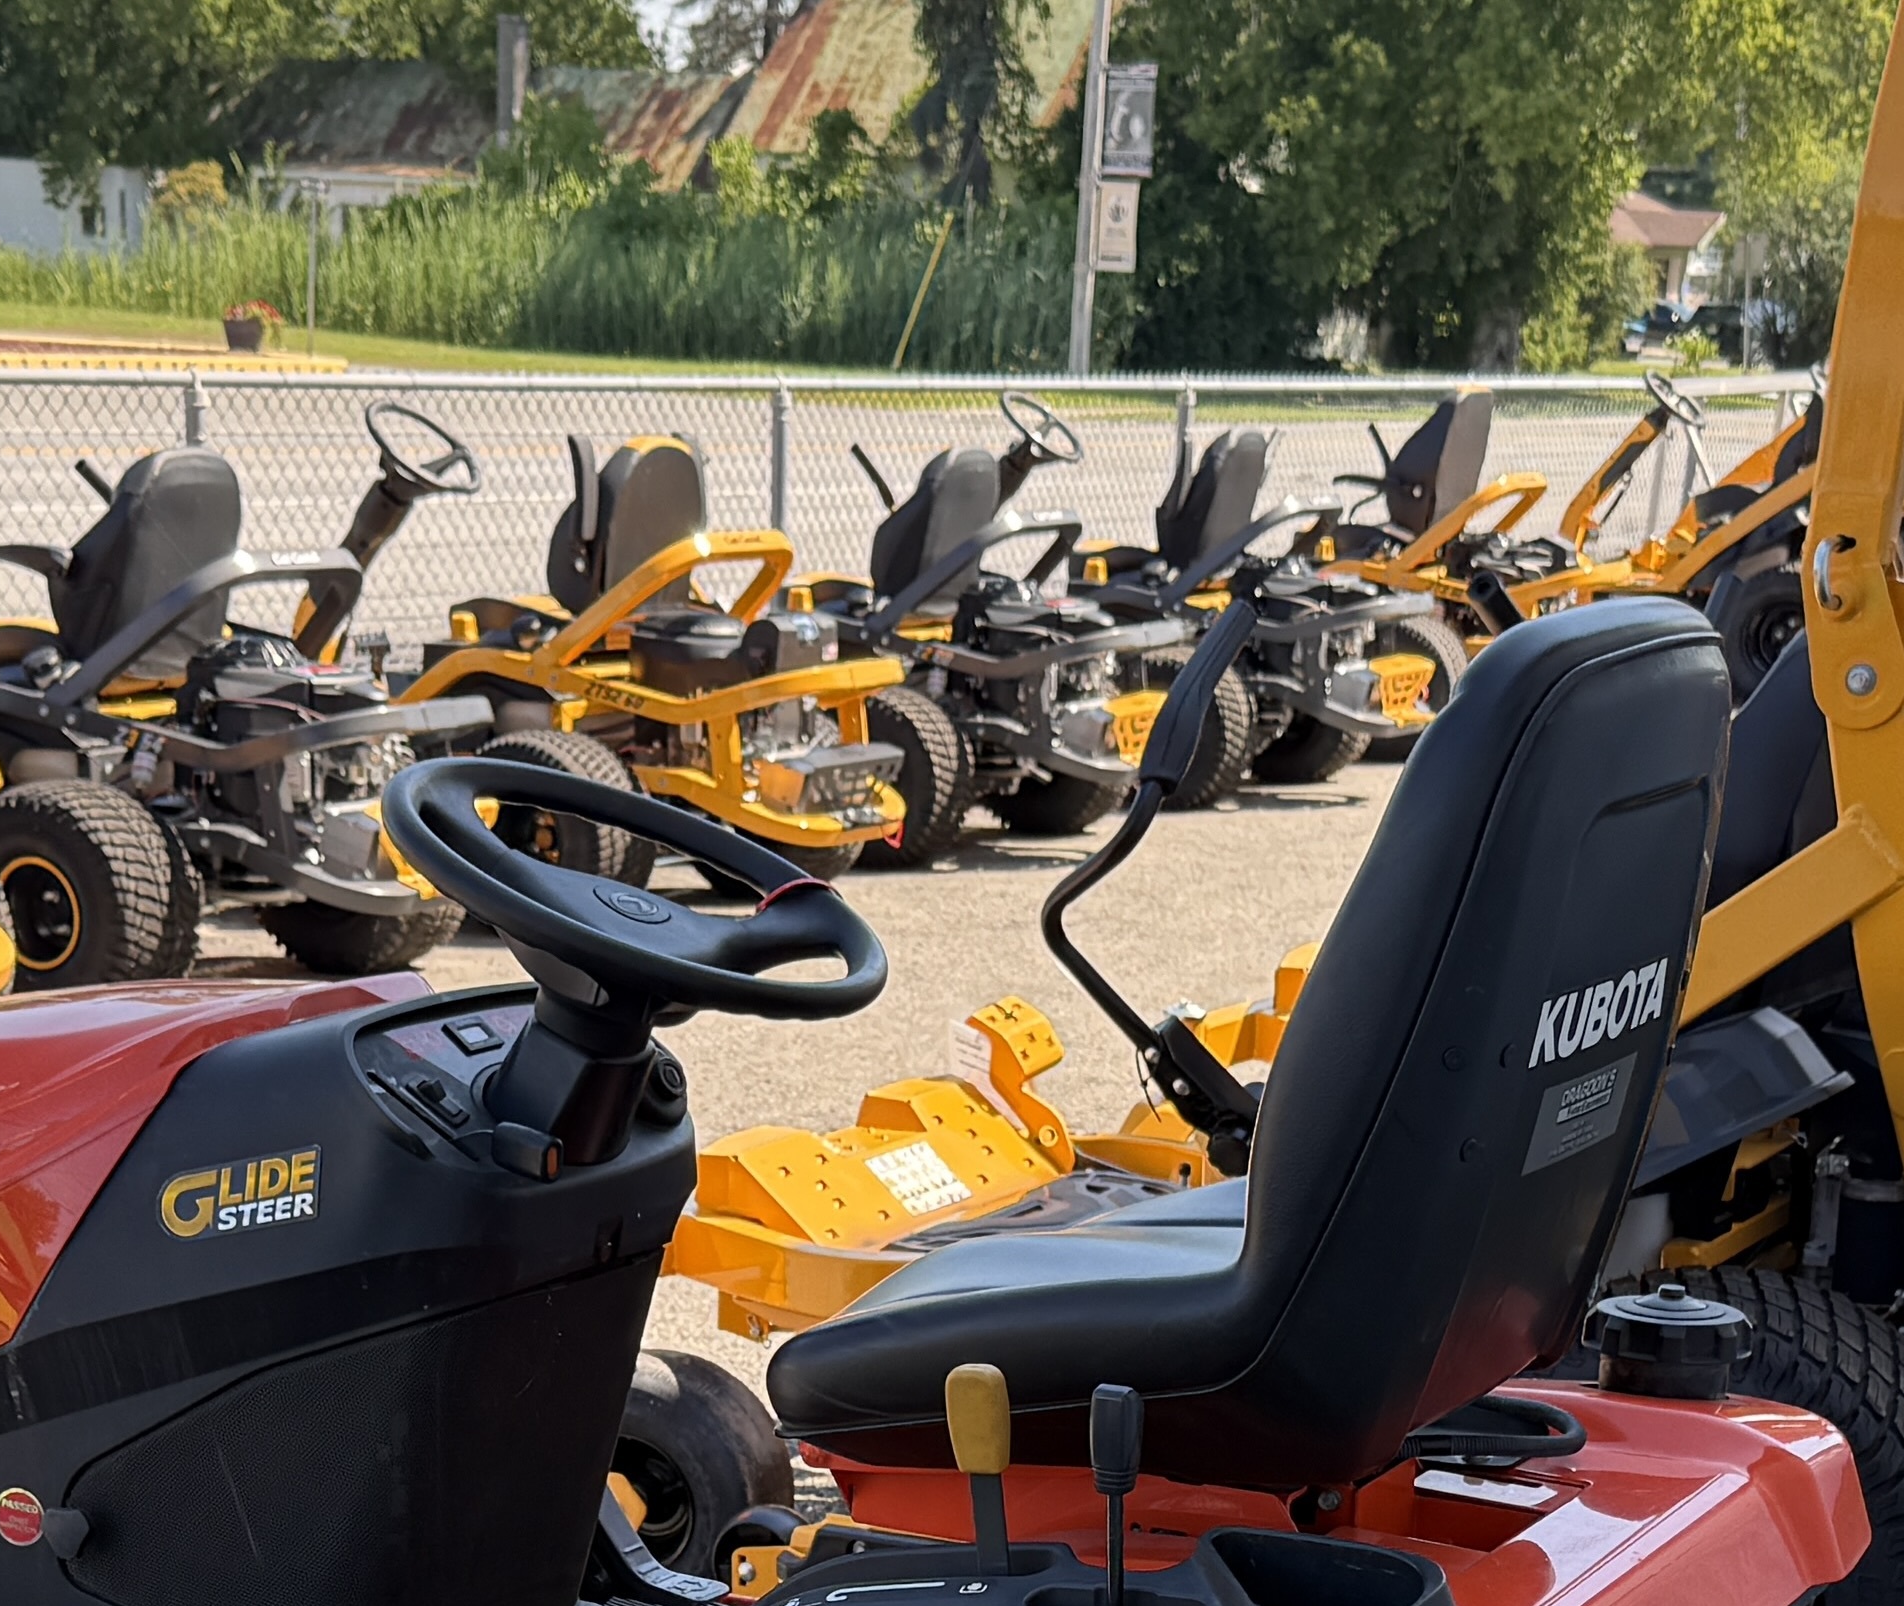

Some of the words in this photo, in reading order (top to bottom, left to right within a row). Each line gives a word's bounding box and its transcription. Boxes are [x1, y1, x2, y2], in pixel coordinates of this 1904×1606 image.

[1528, 956, 1669, 1069] KUBOTA
[160, 1150, 318, 1238] GLIDE
[217, 1193, 315, 1232] STEER
